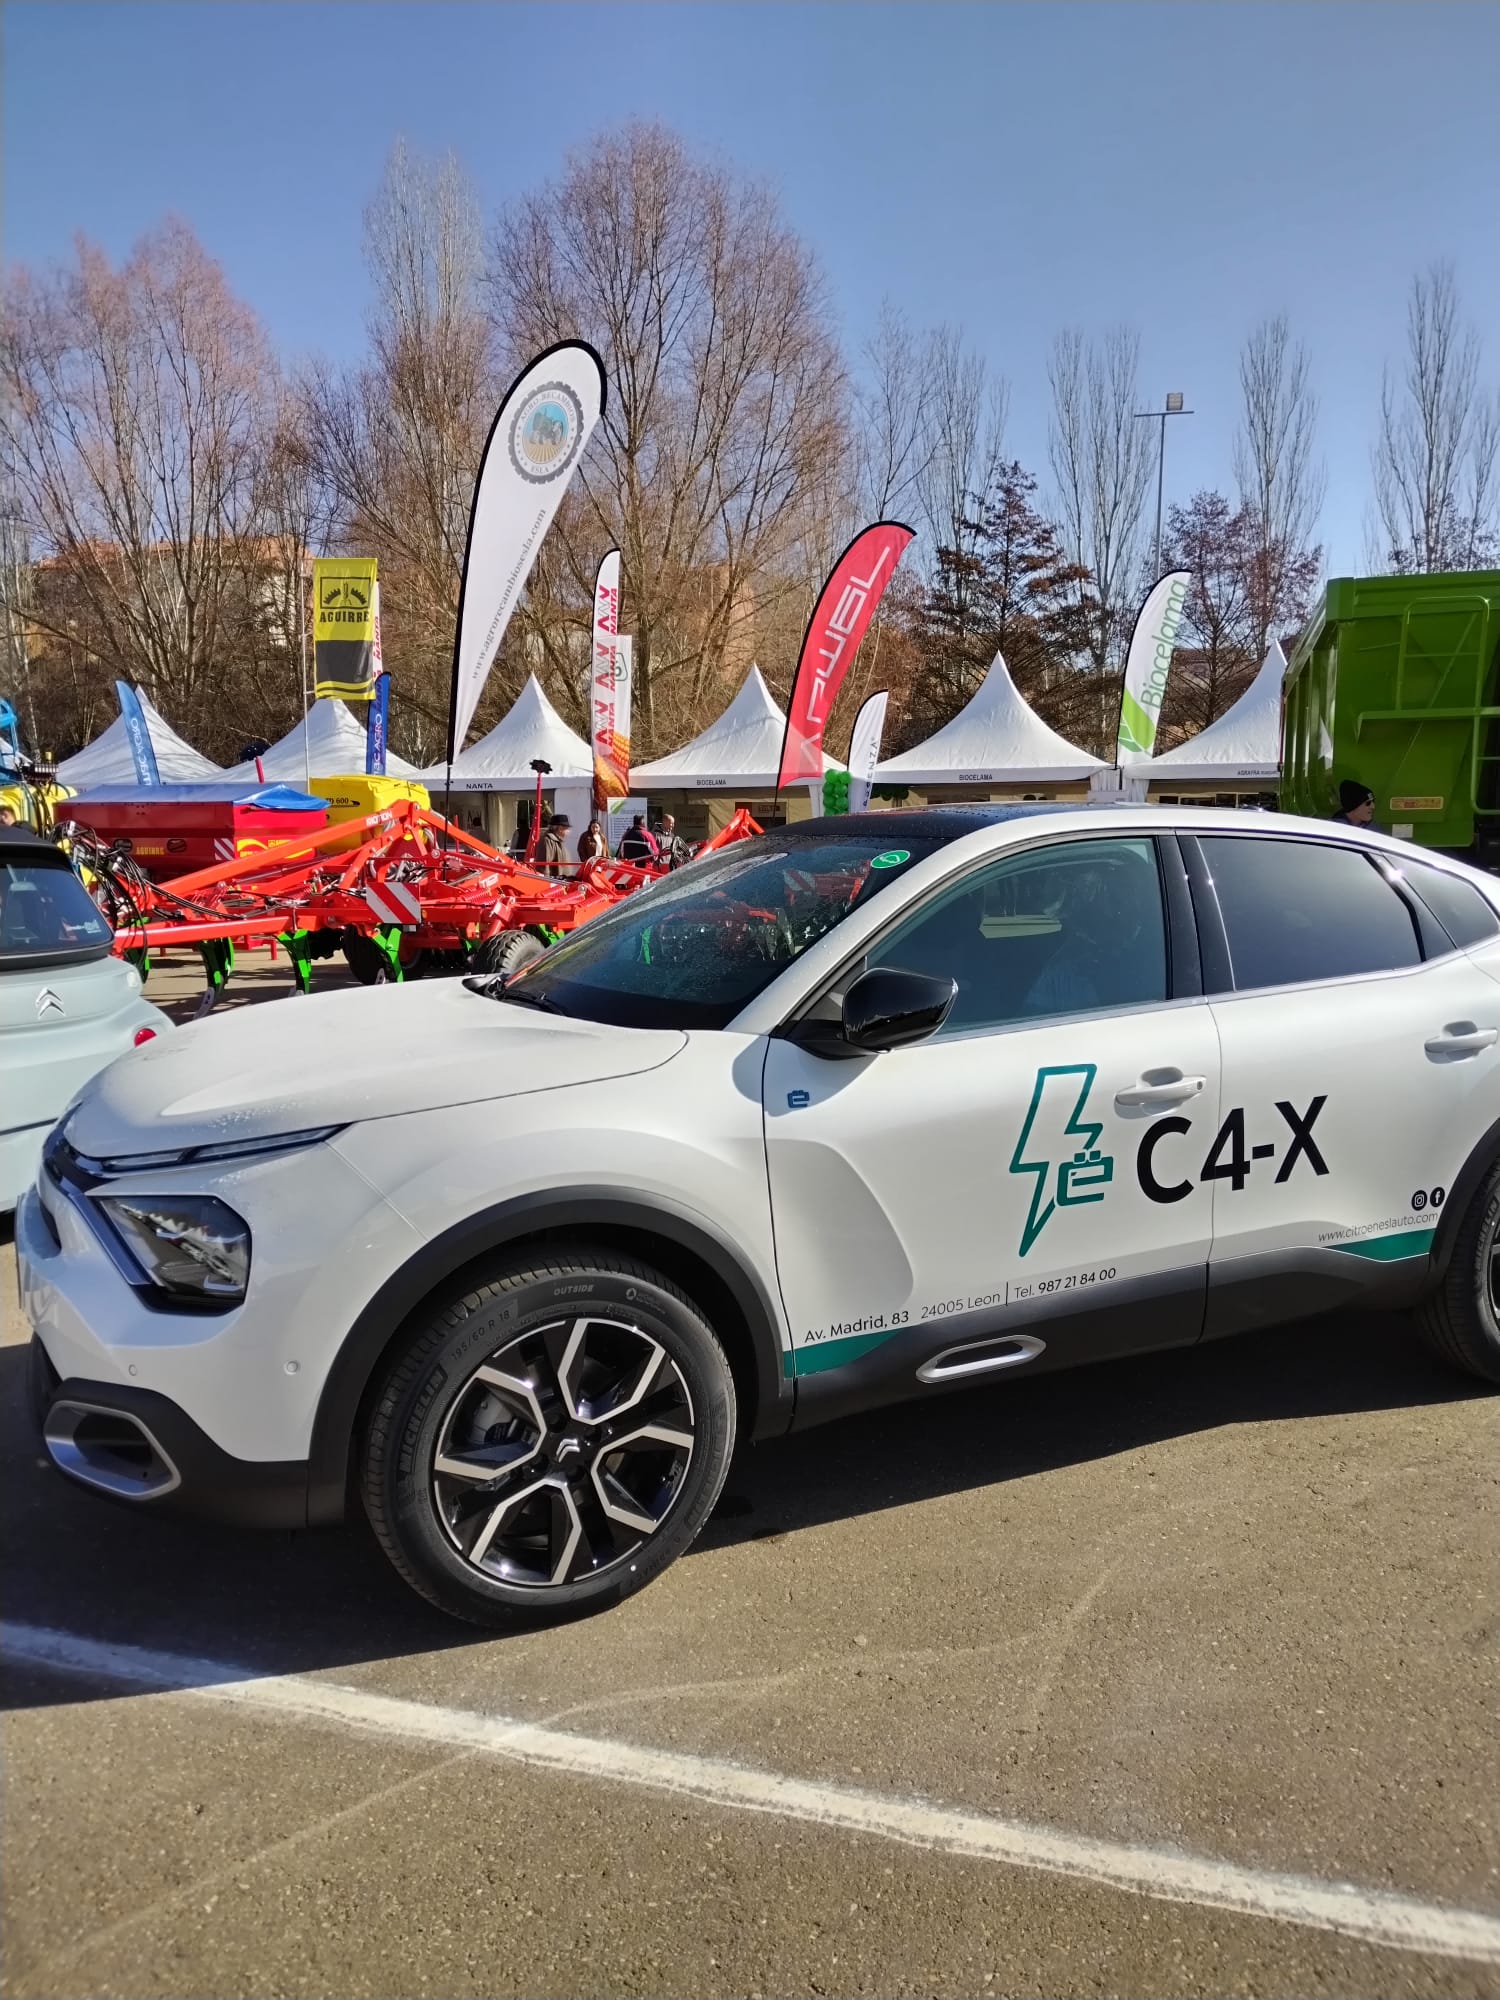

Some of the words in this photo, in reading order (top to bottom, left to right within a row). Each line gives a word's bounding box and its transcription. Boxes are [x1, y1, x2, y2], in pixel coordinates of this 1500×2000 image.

[320, 610, 370, 623] AGUIRRE
[610, 587, 618, 635] NANTA
[1140, 578, 1187, 710] Biocelama
[465, 782, 493, 790] NANTA
[958, 773, 993, 781] BIOCELAMA
[1136, 1094, 1330, 1204] C4-X
[1318, 1211, 1439, 1242] www.citroeneslauto.com
[553, 1284, 595, 1296] OUTSIDE
[804, 1328, 827, 1343] Av.
[829, 1313, 888, 1337] Madrid,
[891, 1310, 910, 1325] 83
[920, 1298, 964, 1319] 24005
[967, 1292, 1001, 1310] Leon
[1014, 1285, 1036, 1300] Tel.
[1038, 1278, 1062, 1294] 987
[1064, 1275, 1078, 1290] 21
[1079, 1272, 1097, 1287] 84
[1099, 1267, 1117, 1282] 00
[450, 1327, 486, 1361] 195/60
[488, 1319, 496, 1329] R
[498, 1310, 511, 1321] 18
